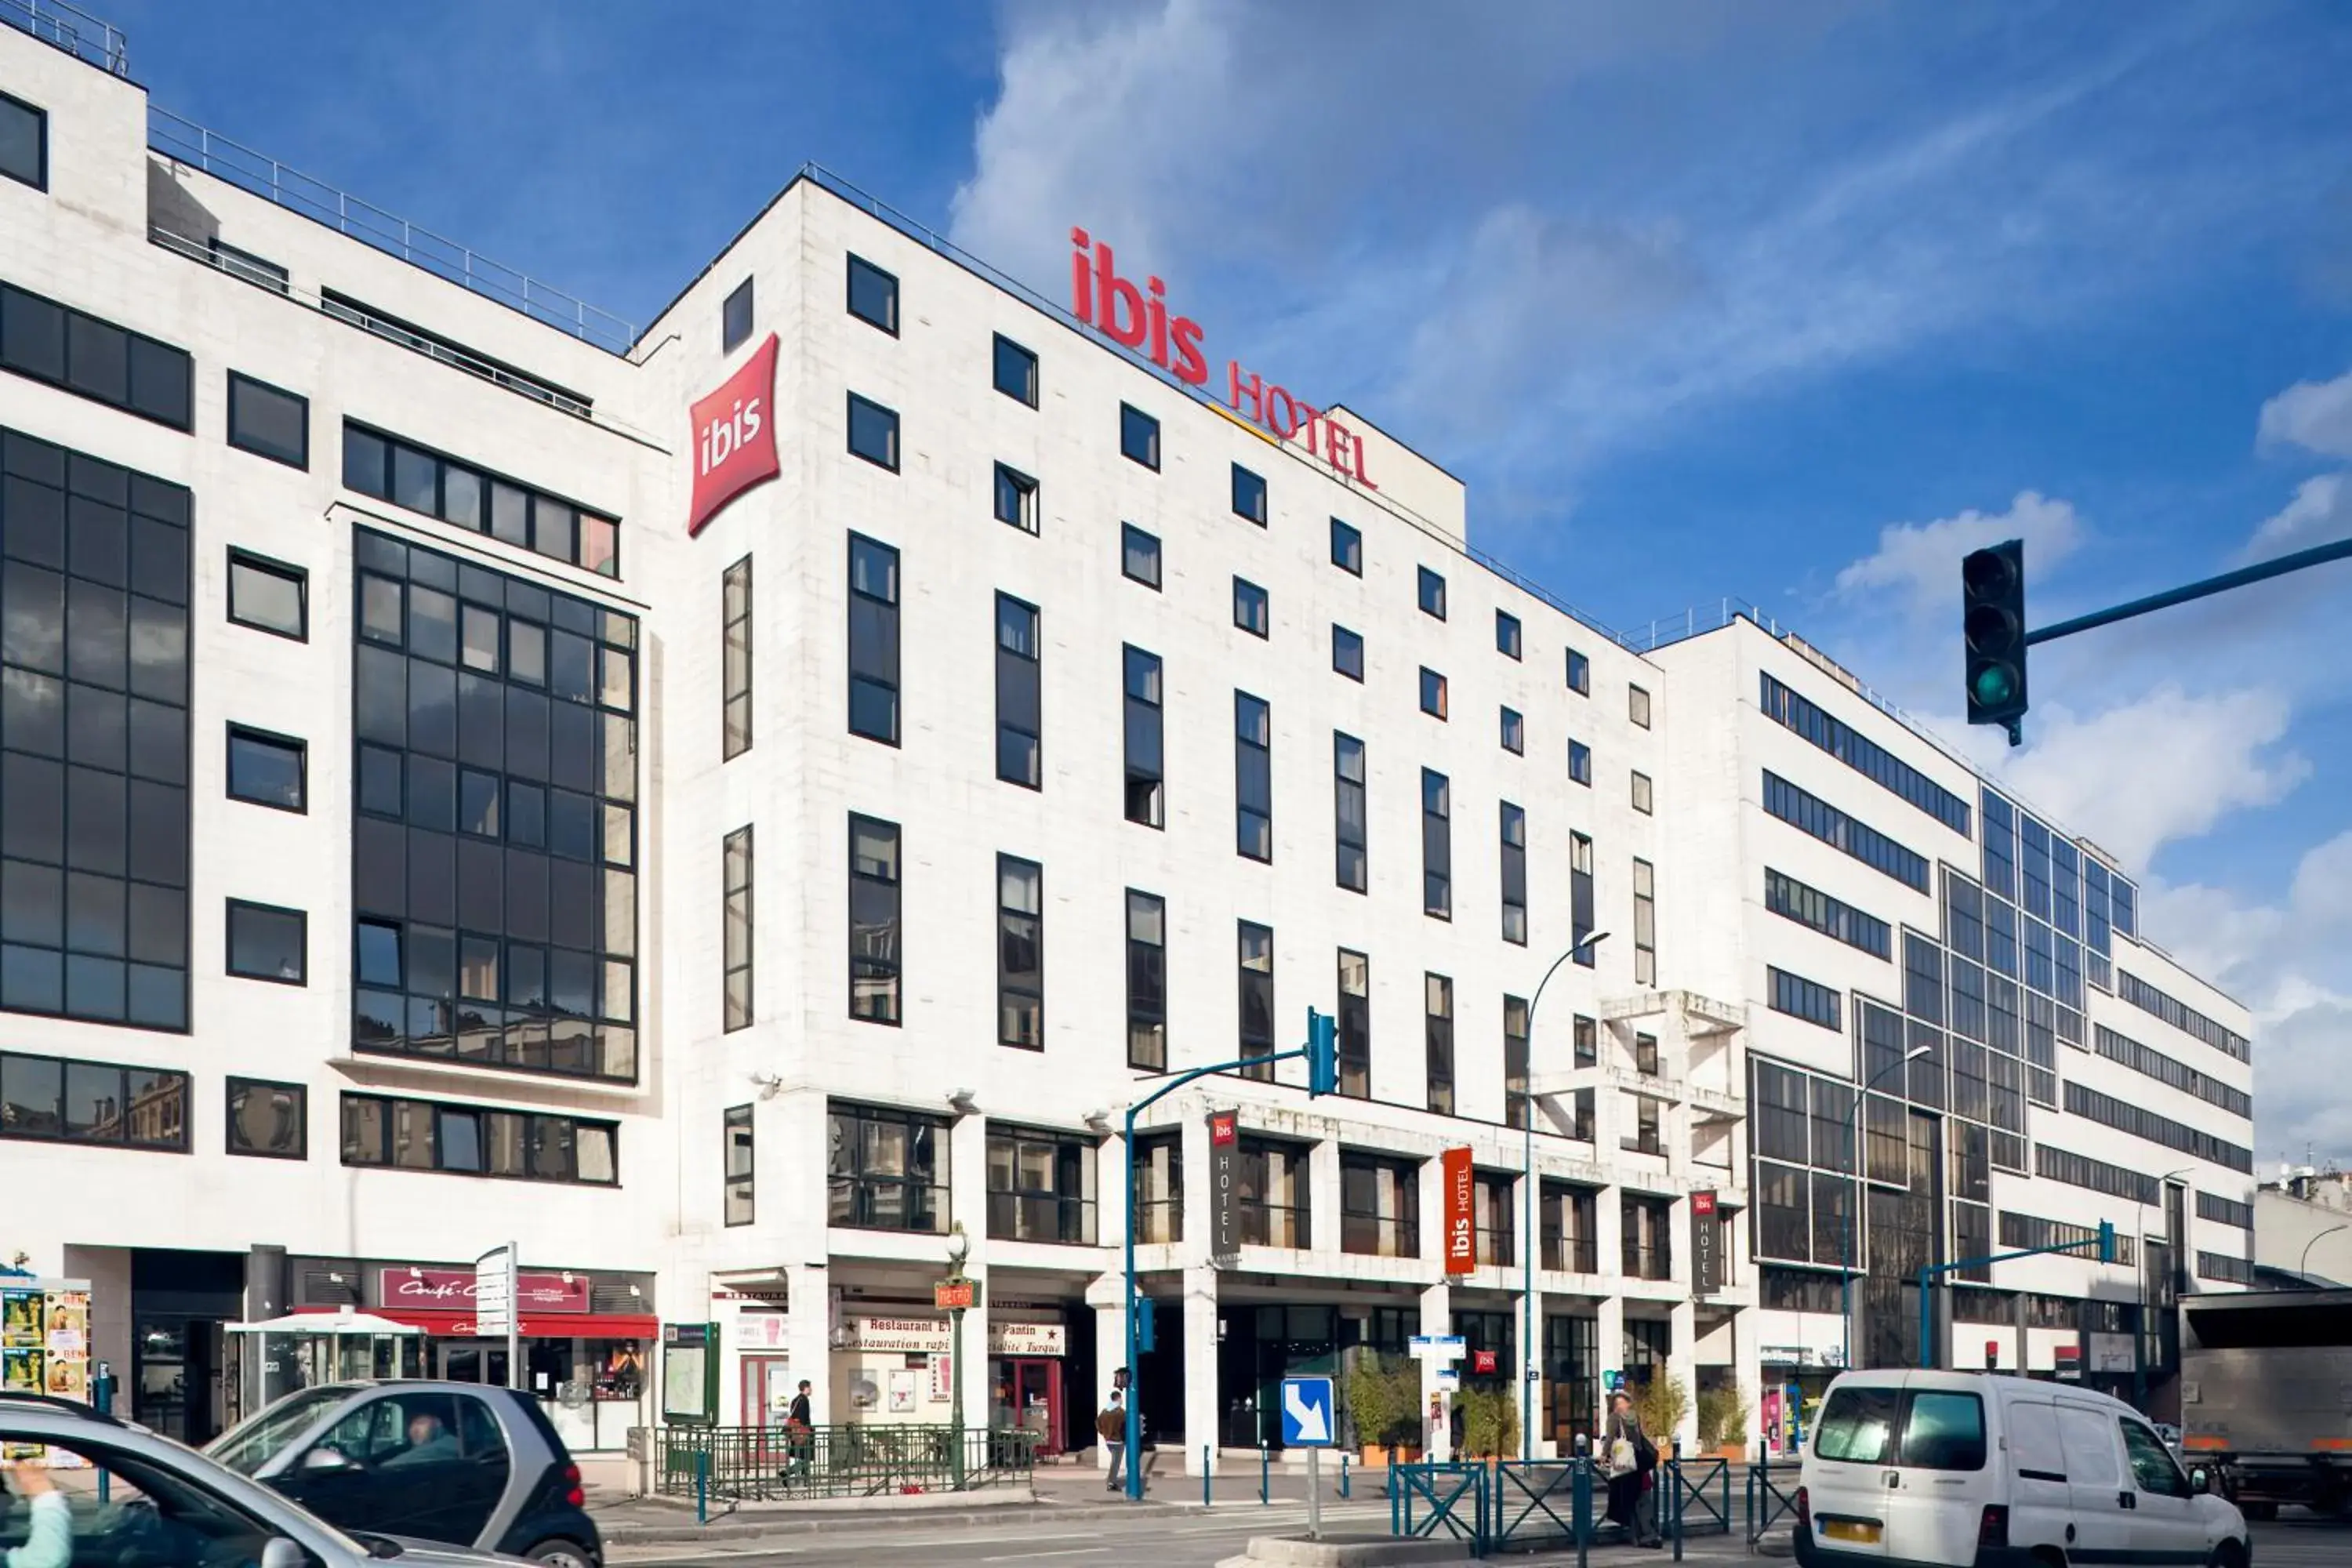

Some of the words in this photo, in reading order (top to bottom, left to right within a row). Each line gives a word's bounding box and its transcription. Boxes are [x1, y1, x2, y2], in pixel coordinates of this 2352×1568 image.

[1071, 226, 1209, 385] ibis
[1227, 361, 1378, 491] HOTEL
[702, 397, 761, 477] ibis
[1216, 1123, 1232, 1138] ibis
[1220, 1156, 1229, 1245] HOTEL
[1457, 1166, 1468, 1212] HOTEL
[1452, 1218, 1470, 1258] ibis
[1700, 1222, 1709, 1287] HOTEL
[848, 1337, 920, 1348] estauration
[926, 1338, 950, 1350] rapi
[870, 1319, 932, 1332] Restaurant
[1004, 1324, 1036, 1335] Pantin
[1479, 1355, 1495, 1367] ibis
